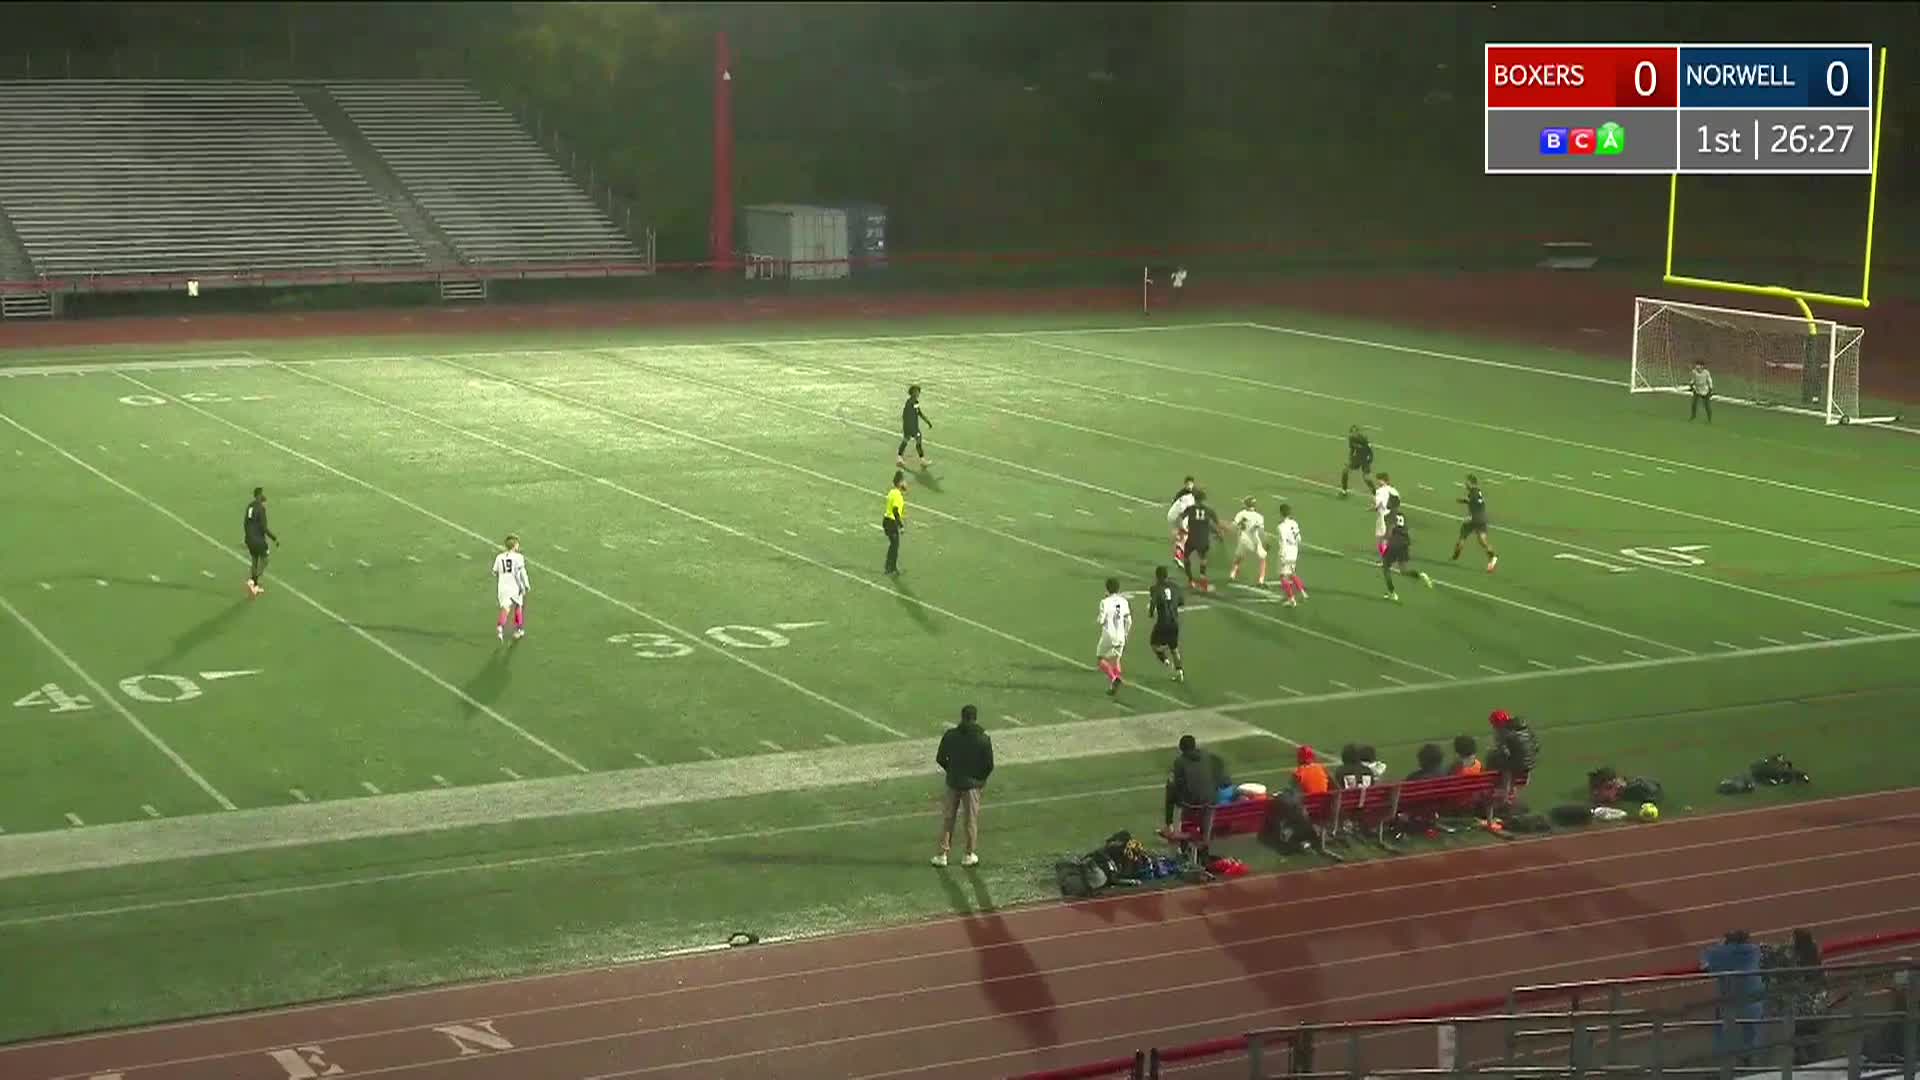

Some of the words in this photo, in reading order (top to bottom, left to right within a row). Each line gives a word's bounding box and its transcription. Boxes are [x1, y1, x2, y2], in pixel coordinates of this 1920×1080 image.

[501, 558, 513, 574] 19
[1553, 546, 1706, 574] 10
[607, 624, 790, 658] 30
[12, 673, 204, 713] 40
